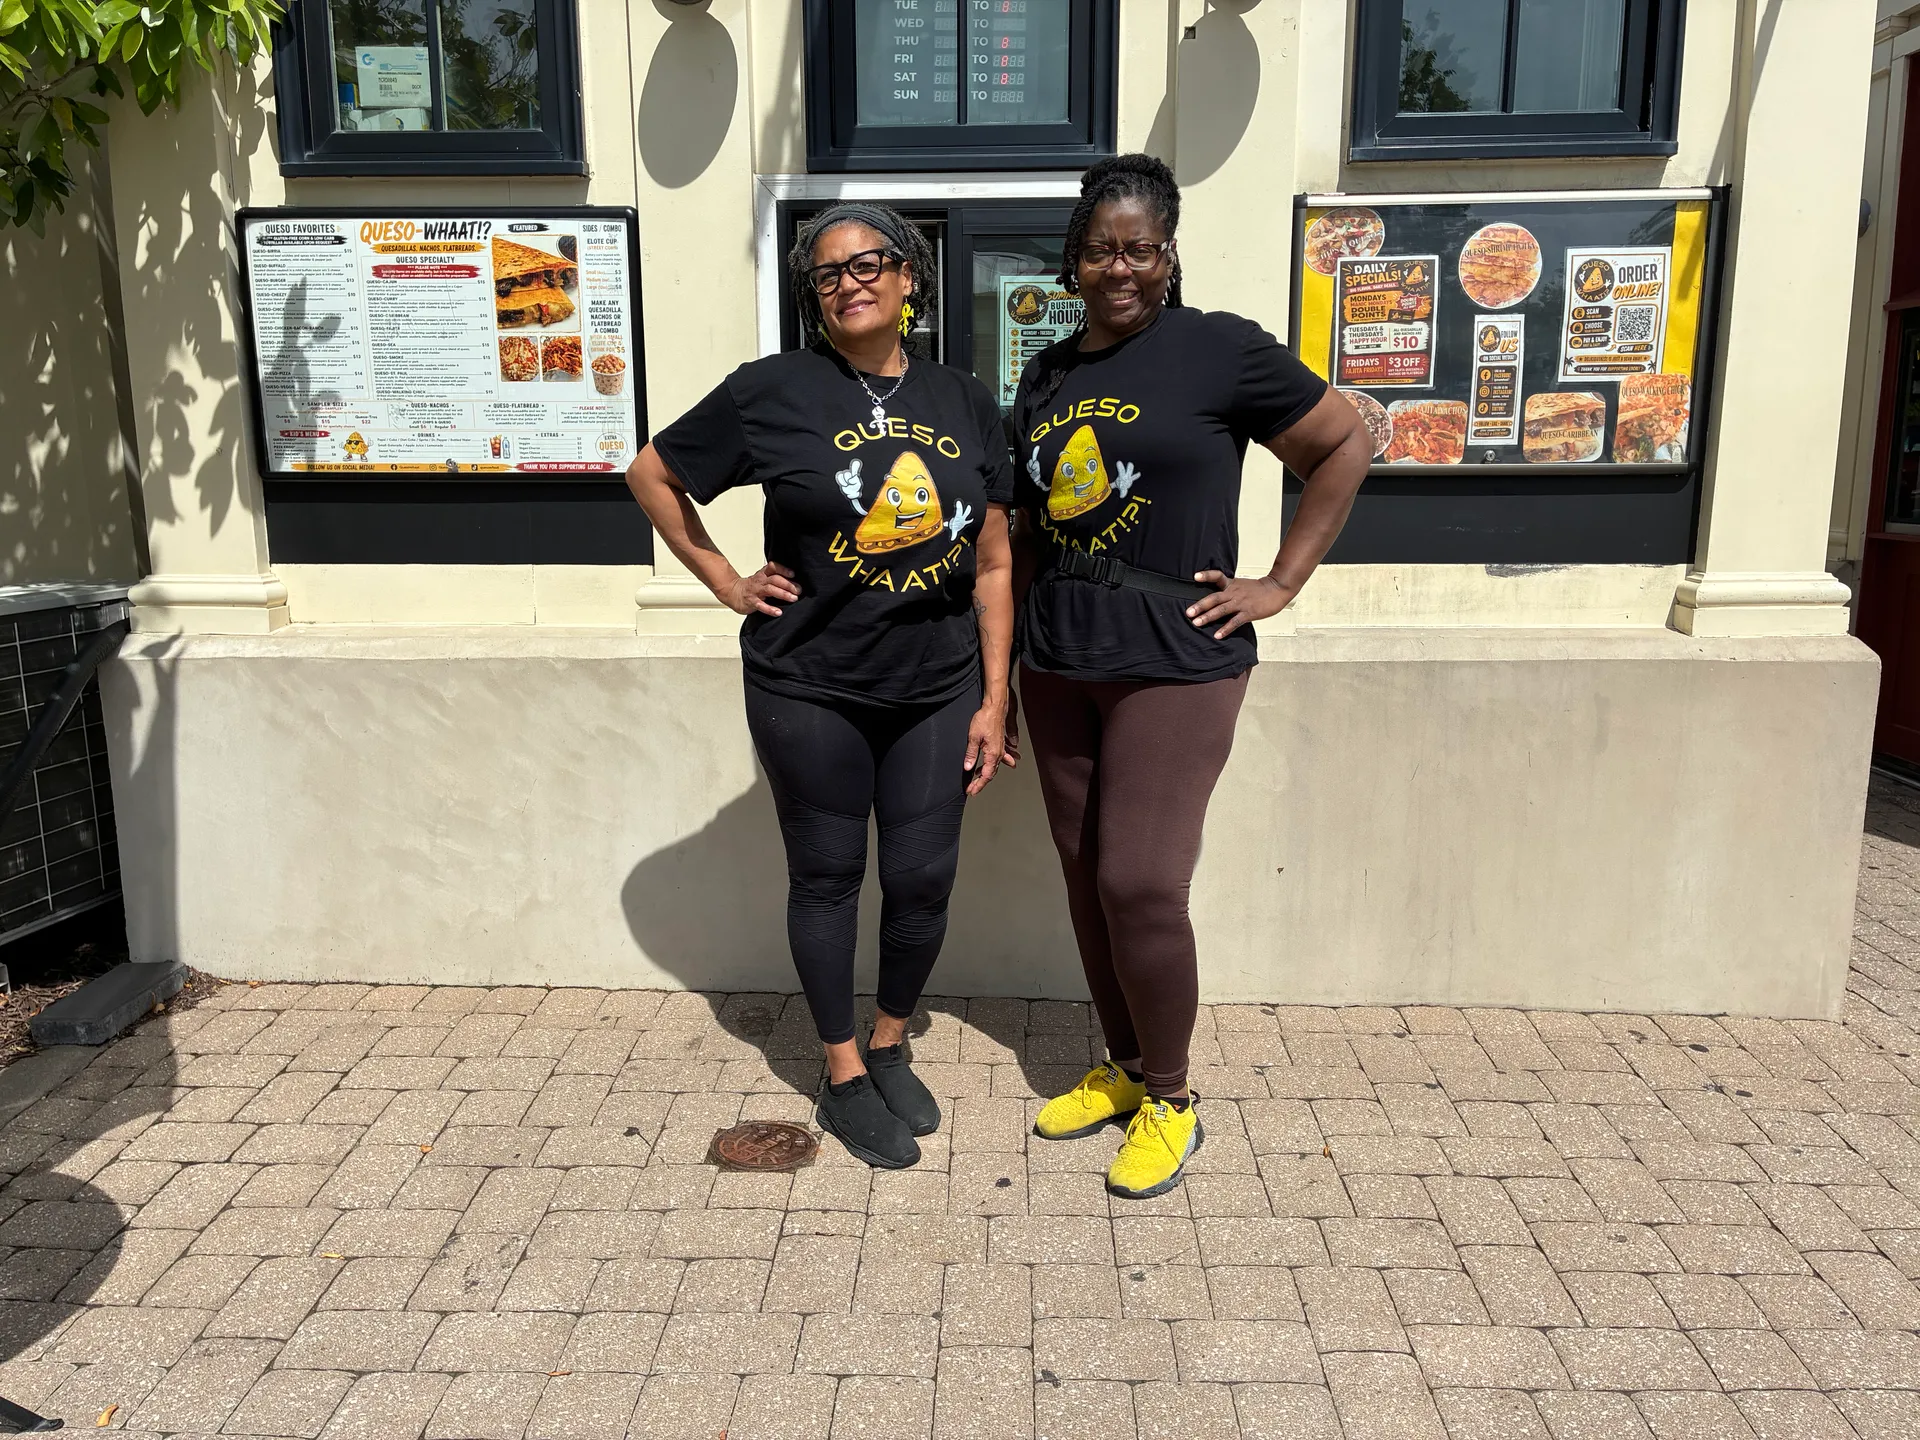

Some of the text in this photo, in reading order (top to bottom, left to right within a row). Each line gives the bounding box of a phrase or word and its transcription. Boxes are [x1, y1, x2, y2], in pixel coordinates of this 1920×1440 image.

[895, 0, 990, 10] TUE TO
[894, 18, 989, 28] WED TO
[894, 36, 989, 46] THU TO
[894, 54, 989, 64] FRI TO
[894, 72, 988, 82] SAT TO
[894, 90, 988, 100] SUN TO
[265, 224, 335, 234] QUESO FAVORITES
[396, 256, 417, 264] QUESO
[1354, 263, 1388, 275] DAILY
[1582, 260, 1610, 271] QUESO
[1619, 263, 1658, 284] ORDER
[1345, 270, 1401, 288] SPECIALS!
[1015, 286, 1043, 297] QUESO
[1043, 290, 1082, 302] SUMME
[1612, 282, 1662, 301] ONLINE!
[1350, 294, 1386, 302] MONDAYS
[1051, 301, 1086, 310] BUSINES
[1393, 336, 1419, 349] $10
[1500, 338, 1519, 353] US
[1346, 358, 1379, 367] FRIDAYS
[1388, 357, 1420, 367] $3 OFF
[1030, 397, 1141, 442] QUESO
[834, 417, 961, 459] QUESO
[599, 441, 625, 451] QUESO
